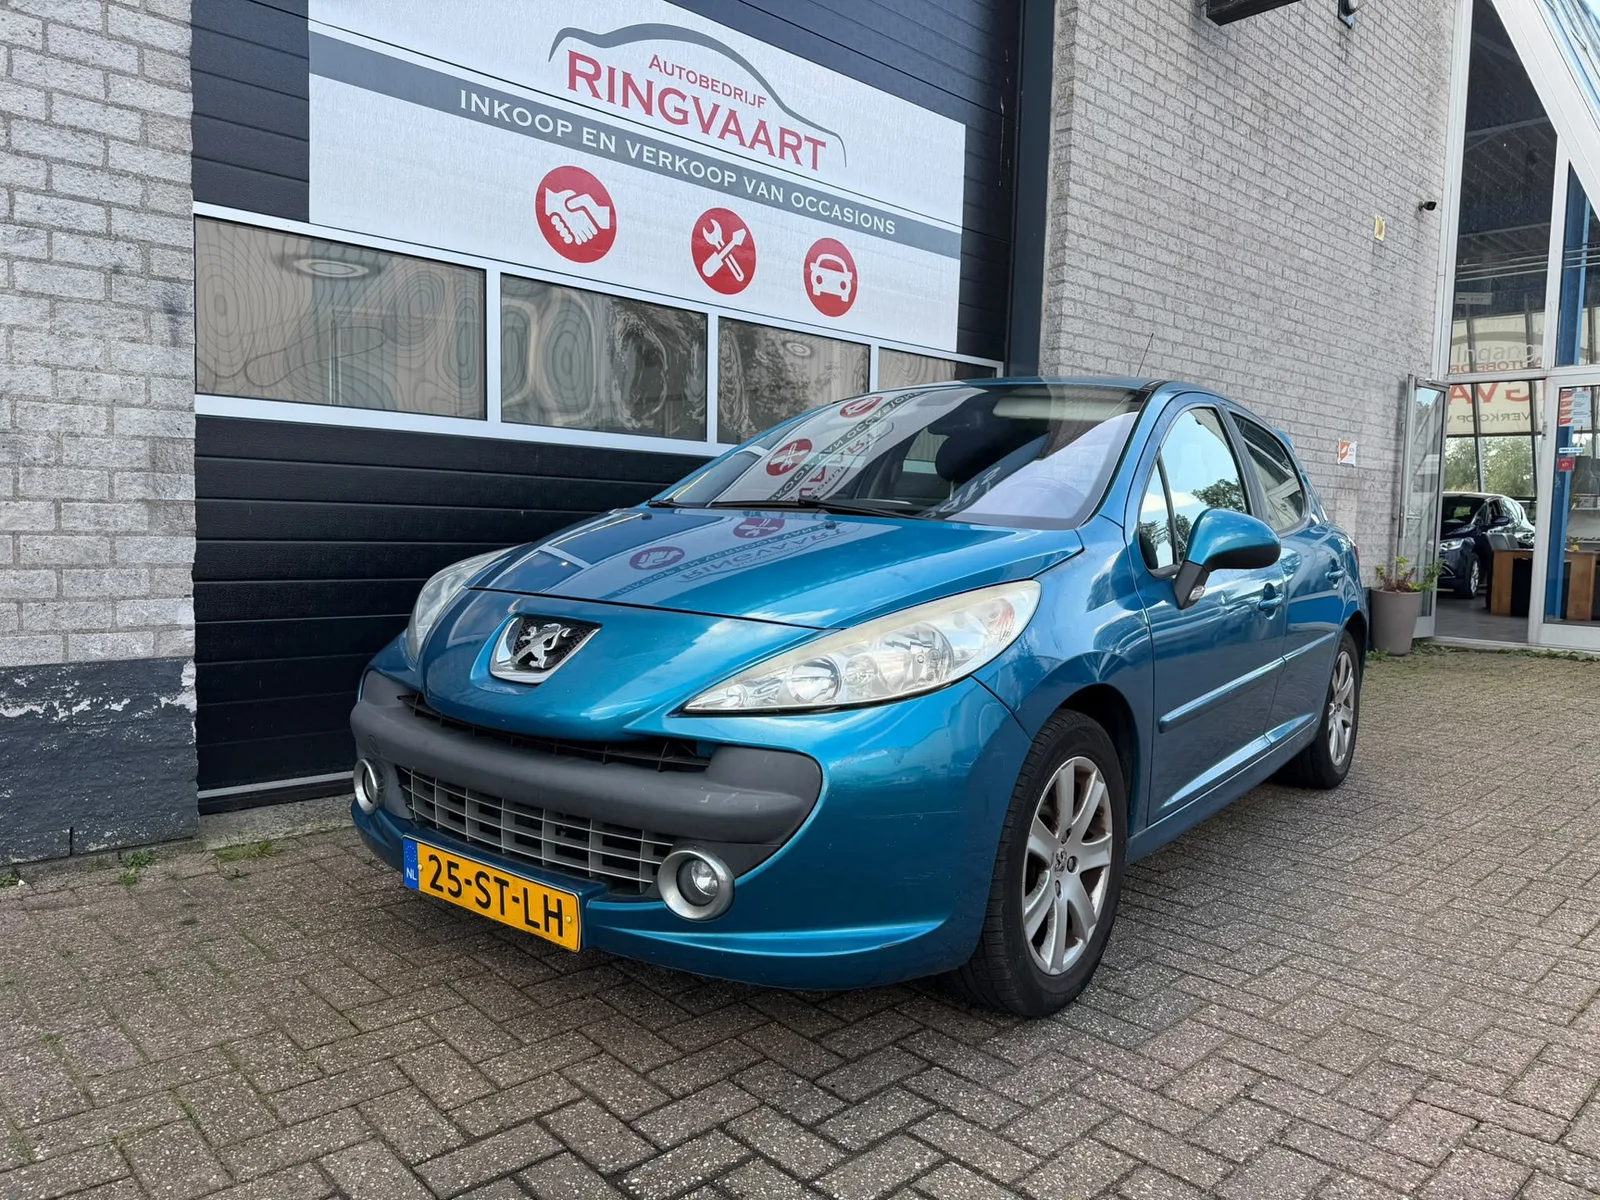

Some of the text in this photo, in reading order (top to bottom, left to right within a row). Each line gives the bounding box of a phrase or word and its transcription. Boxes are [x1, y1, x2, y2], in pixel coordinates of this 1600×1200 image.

[566, 49, 827, 171] RINGVAART
[648, 54, 767, 109] AUTOBEDRIJF
[459, 89, 896, 236] INKOOP EN VERKOOP VAN OCCASIONS
[1457, 343, 1535, 366] Ingang
[406, 867, 418, 882] NL
[428, 854, 564, 938] 25-ST-LH
